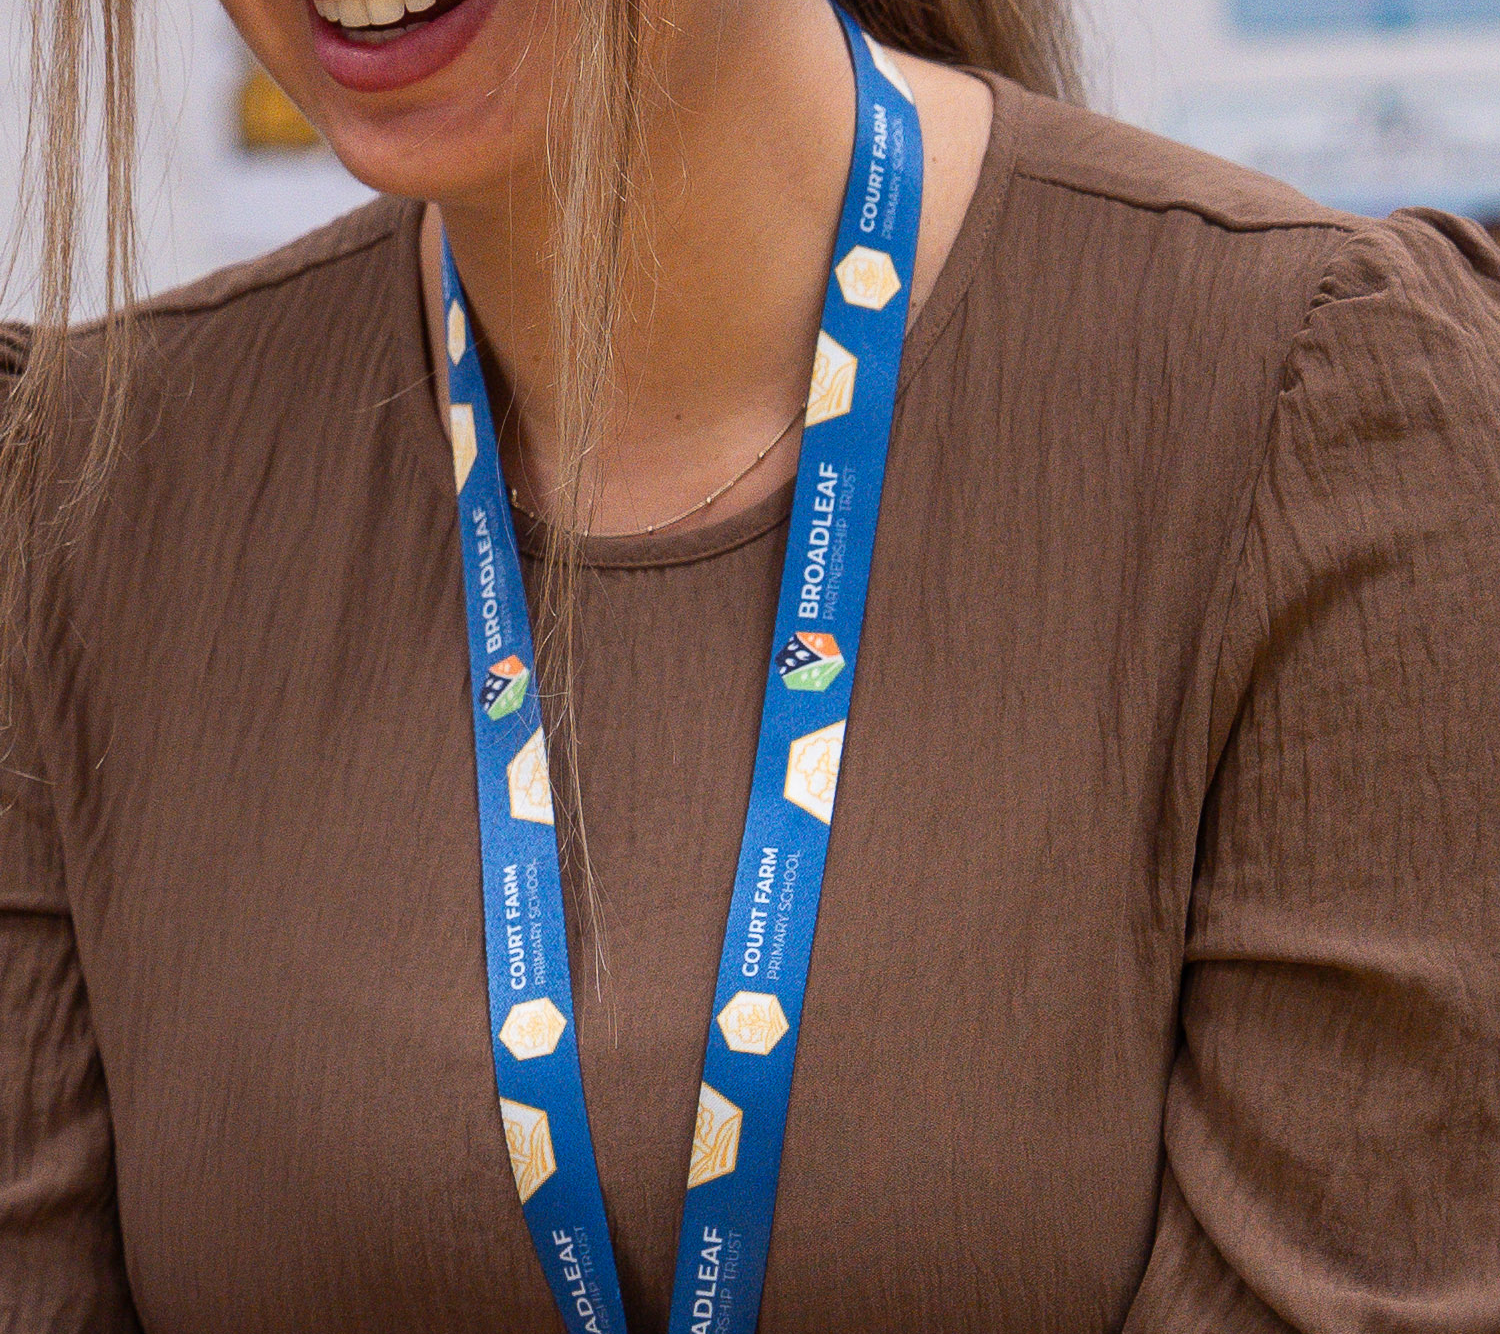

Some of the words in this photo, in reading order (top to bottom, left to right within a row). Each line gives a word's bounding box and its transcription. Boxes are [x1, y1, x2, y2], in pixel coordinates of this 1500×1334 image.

[860, 161, 885, 233] COURT
[873, 103, 888, 160] FARM
[798, 461, 838, 619] BROADLEAF
[822, 517, 849, 620] PARTNERSHIP
[839, 466, 856, 511] TRUST
[472, 506, 502, 655] BROADLEAF
[503, 864, 520, 920] FARM
[525, 858, 542, 920] SCHOOL
[754, 847, 778, 904] FARM
[778, 850, 801, 911] SCHOOL
[507, 924, 527, 990] COURT
[530, 922, 546, 986] PRIMARY
[741, 908, 768, 977] COURT
[767, 914, 790, 981] PRIMARY
[722, 1228, 742, 1281] TRUST
